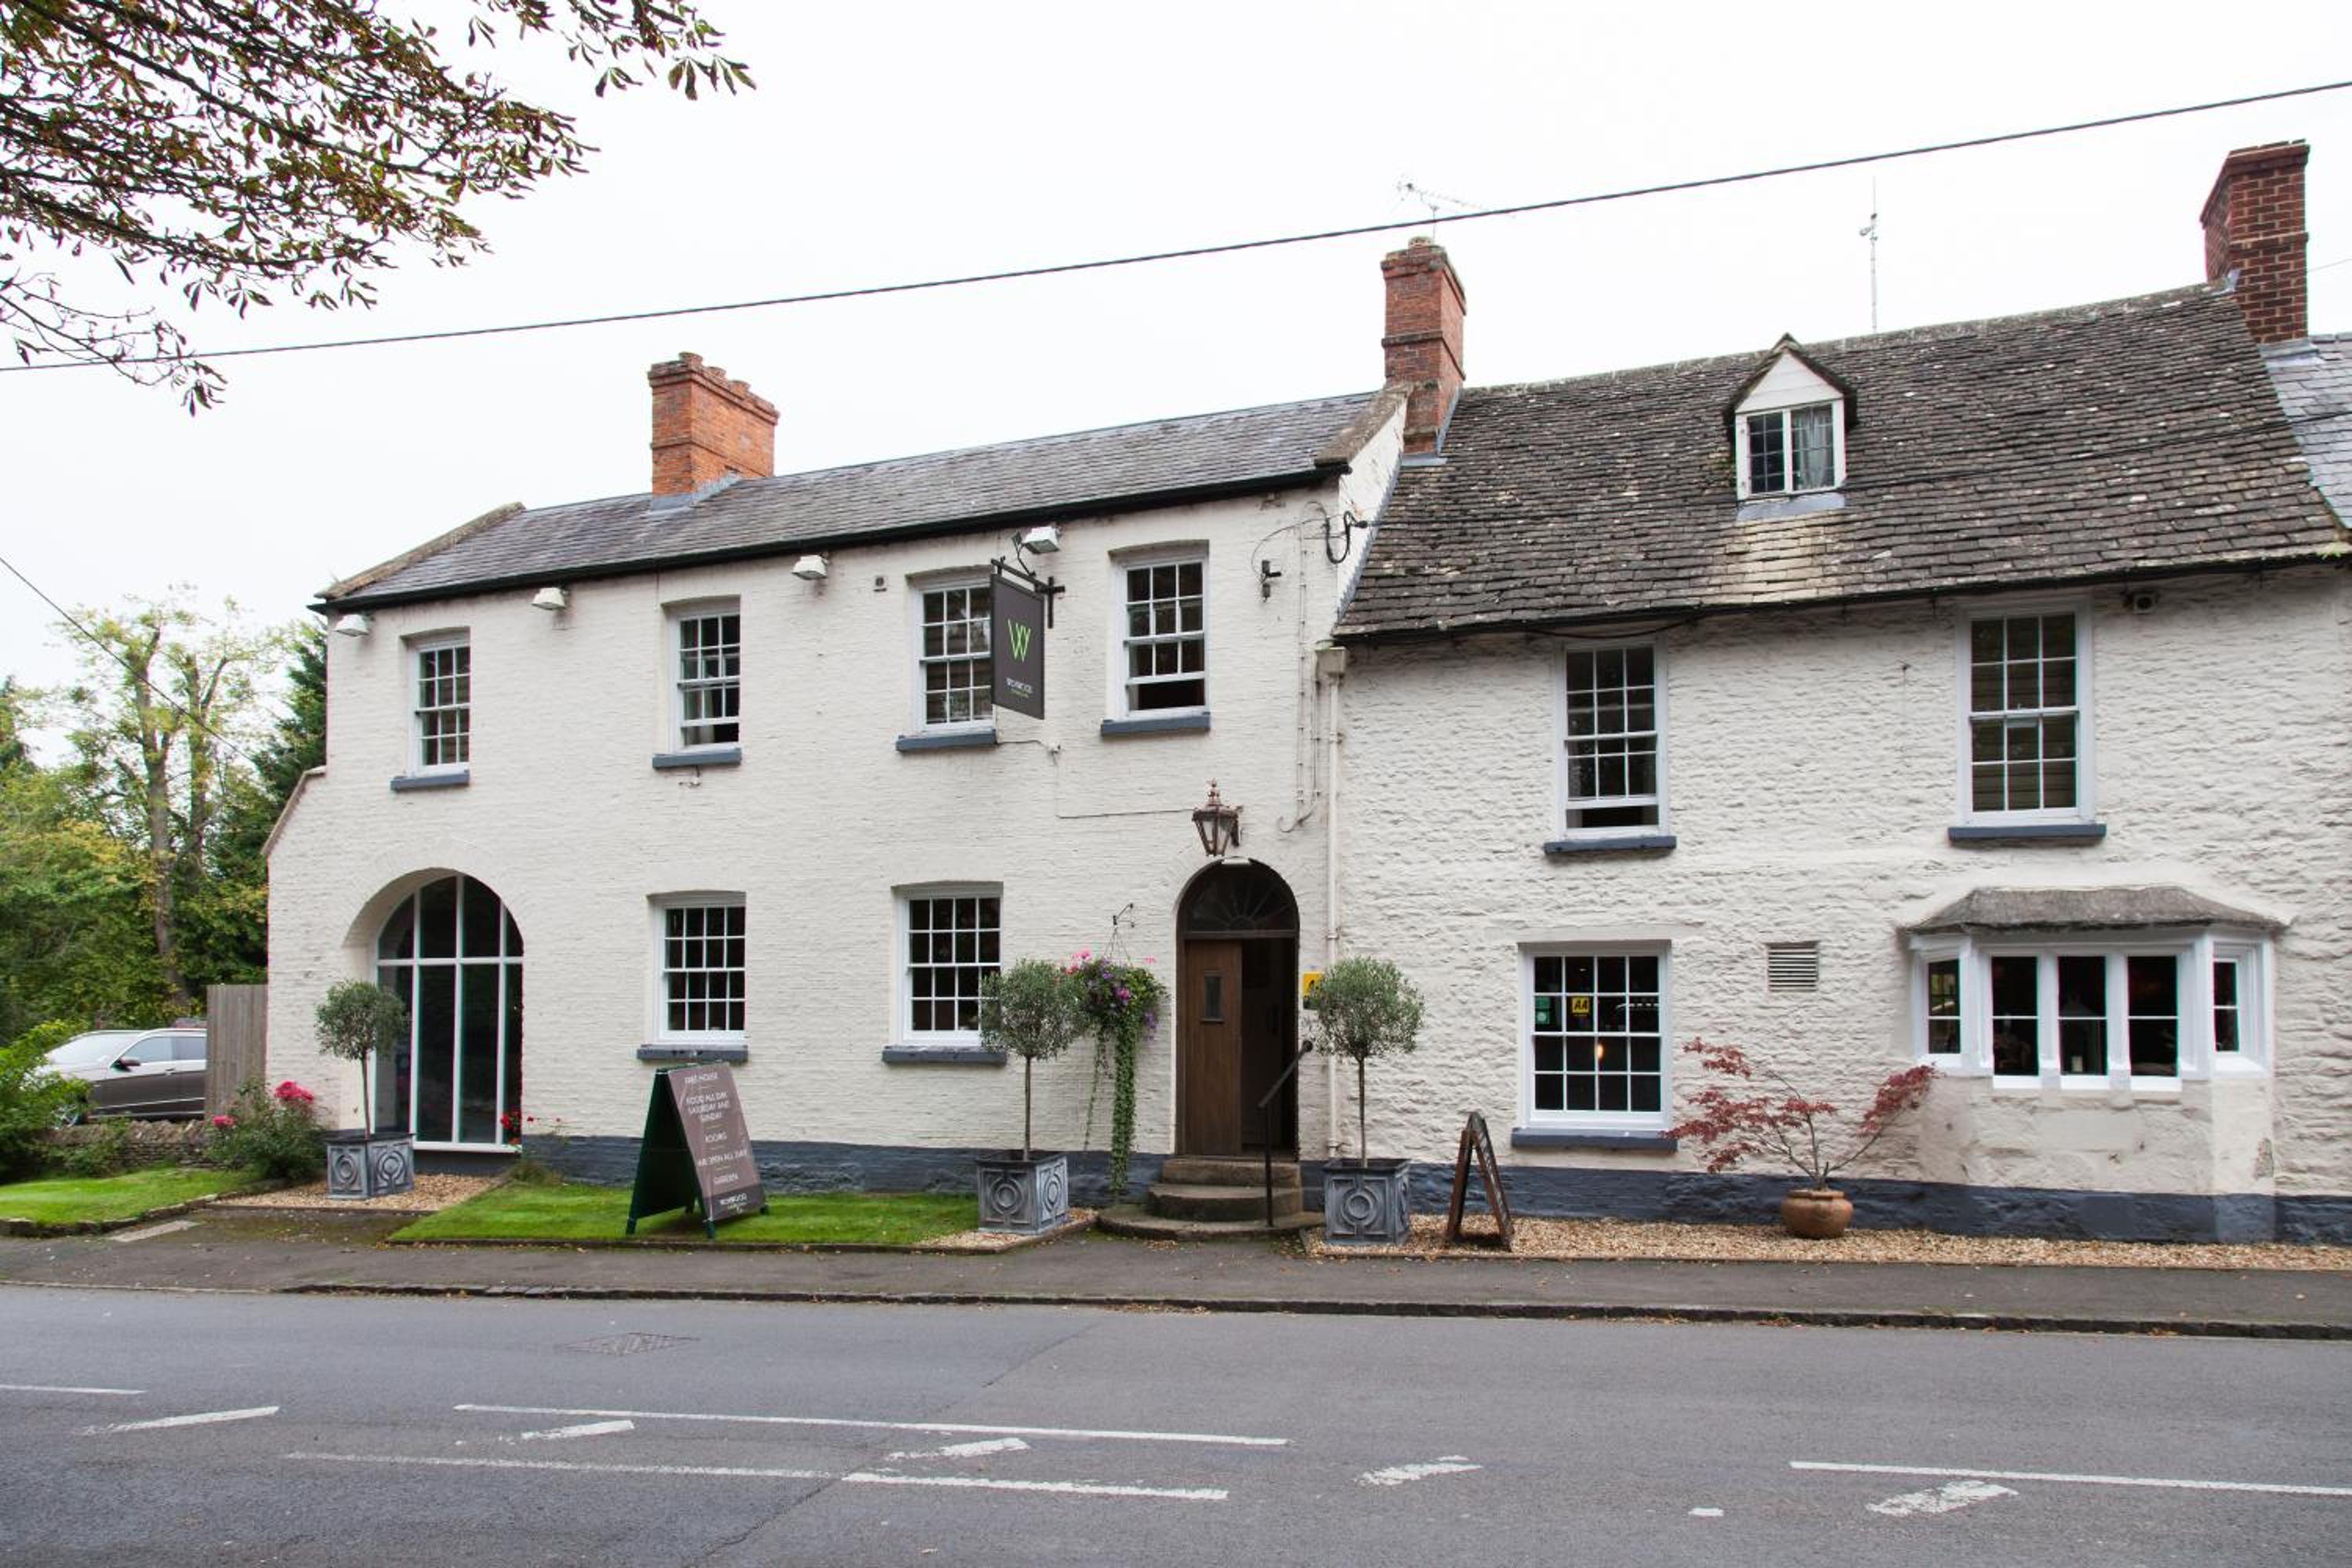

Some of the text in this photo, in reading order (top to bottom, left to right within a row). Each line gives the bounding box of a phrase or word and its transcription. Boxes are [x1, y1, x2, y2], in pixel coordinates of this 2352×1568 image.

[1007, 618, 1032, 663] W
[1573, 1000, 1588, 1011] AA
[686, 1091, 727, 1105] FOOD ALL DAY
[688, 1102, 715, 1114] SATURDAY
[724, 1152, 734, 1161] ALL
[735, 1149, 747, 1159] DAY
